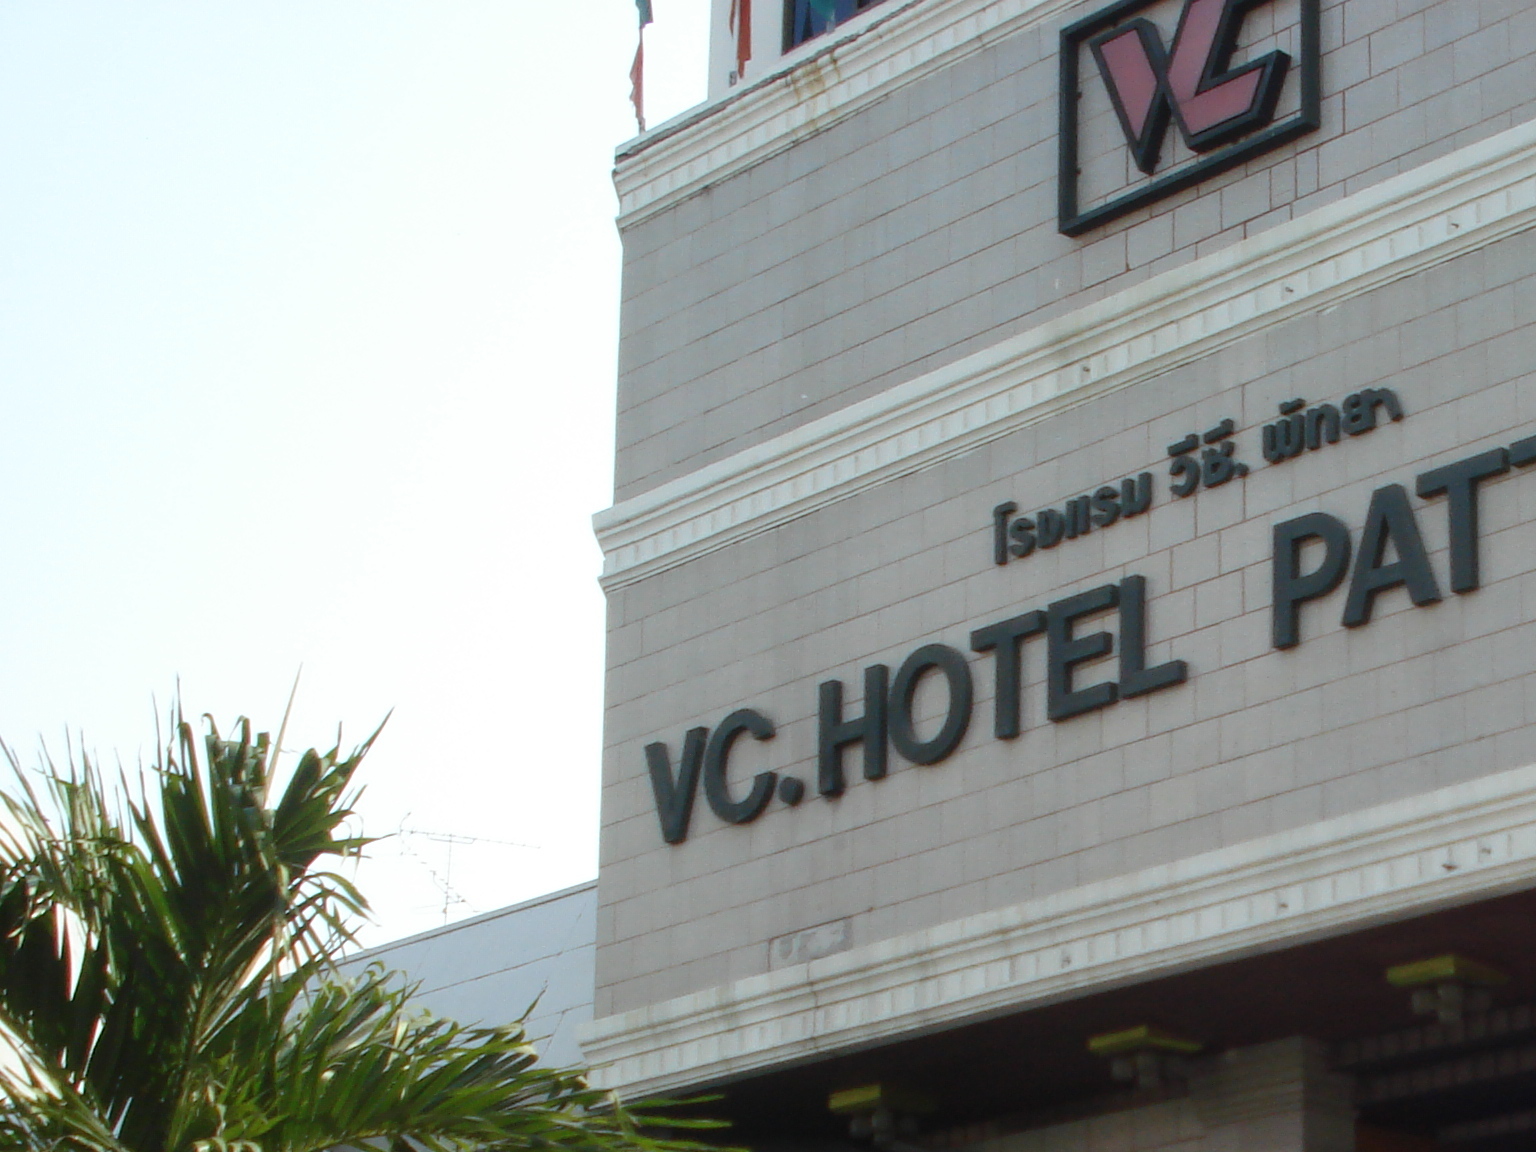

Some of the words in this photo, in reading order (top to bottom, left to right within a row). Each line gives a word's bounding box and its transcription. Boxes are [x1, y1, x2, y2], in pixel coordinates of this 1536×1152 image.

[993, 471, 1153, 565] โรงแรม
[1262, 387, 1404, 465] พัทยา
[818, 573, 1188, 799] HOTEL
